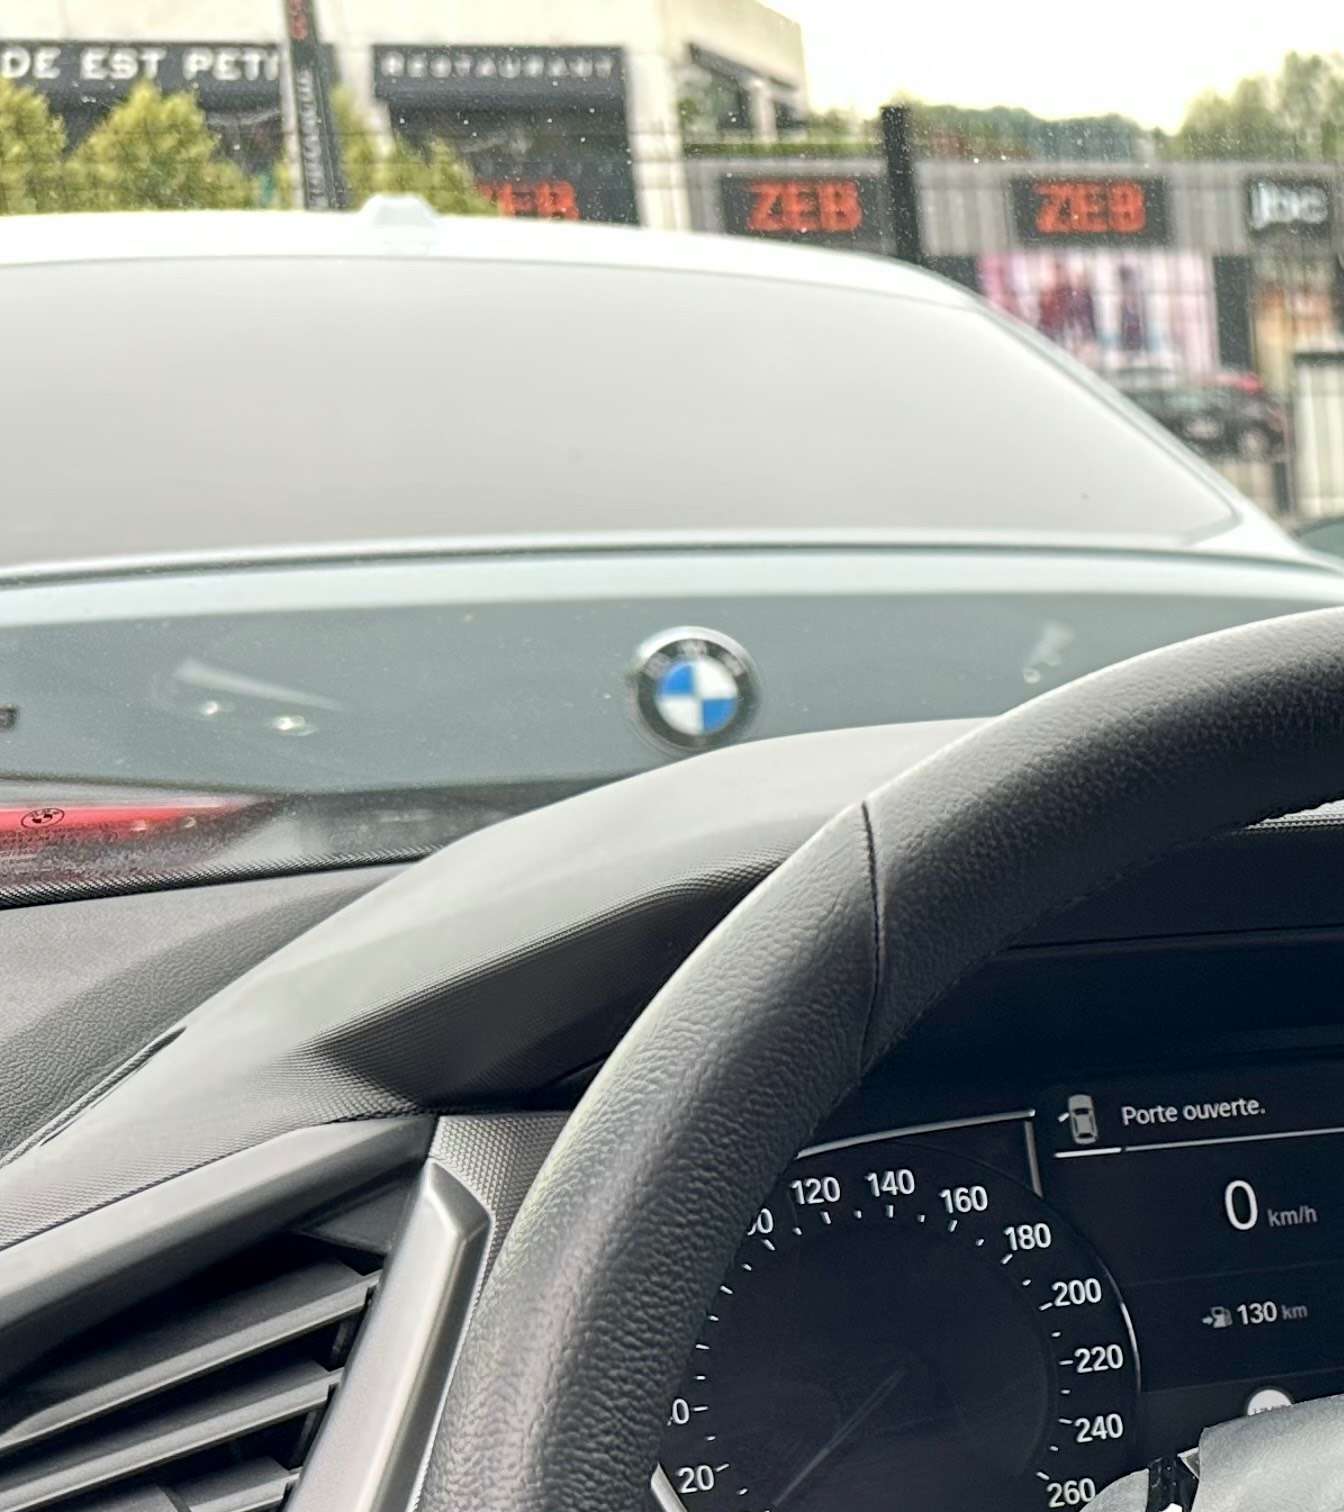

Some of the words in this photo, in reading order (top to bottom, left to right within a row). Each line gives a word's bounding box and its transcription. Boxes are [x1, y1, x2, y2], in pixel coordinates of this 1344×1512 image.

[80, 48, 164, 79] EST
[182, 48, 280, 80] PETI
[745, 179, 863, 232] ZEB
[1033, 180, 1147, 234] ZEB
[1122, 1105, 1178, 1125] Porte
[1183, 1098, 1266, 1121] ouverte.
[792, 1176, 841, 1205] 120
[866, 1169, 916, 1197] 140
[940, 1186, 989, 1214] 160
[1224, 1179, 1259, 1231] 0
[1267, 1205, 1319, 1228] km/h
[1004, 1223, 1052, 1251] 180
[1053, 1278, 1102, 1307] 200
[1236, 1301, 1278, 1326] 130
[1281, 1304, 1309, 1320] km
[1075, 1345, 1124, 1374] 220
[1076, 1414, 1124, 1443] 240
[679, 1465, 714, 1494] 20
[1047, 1478, 1097, 1508] 260
